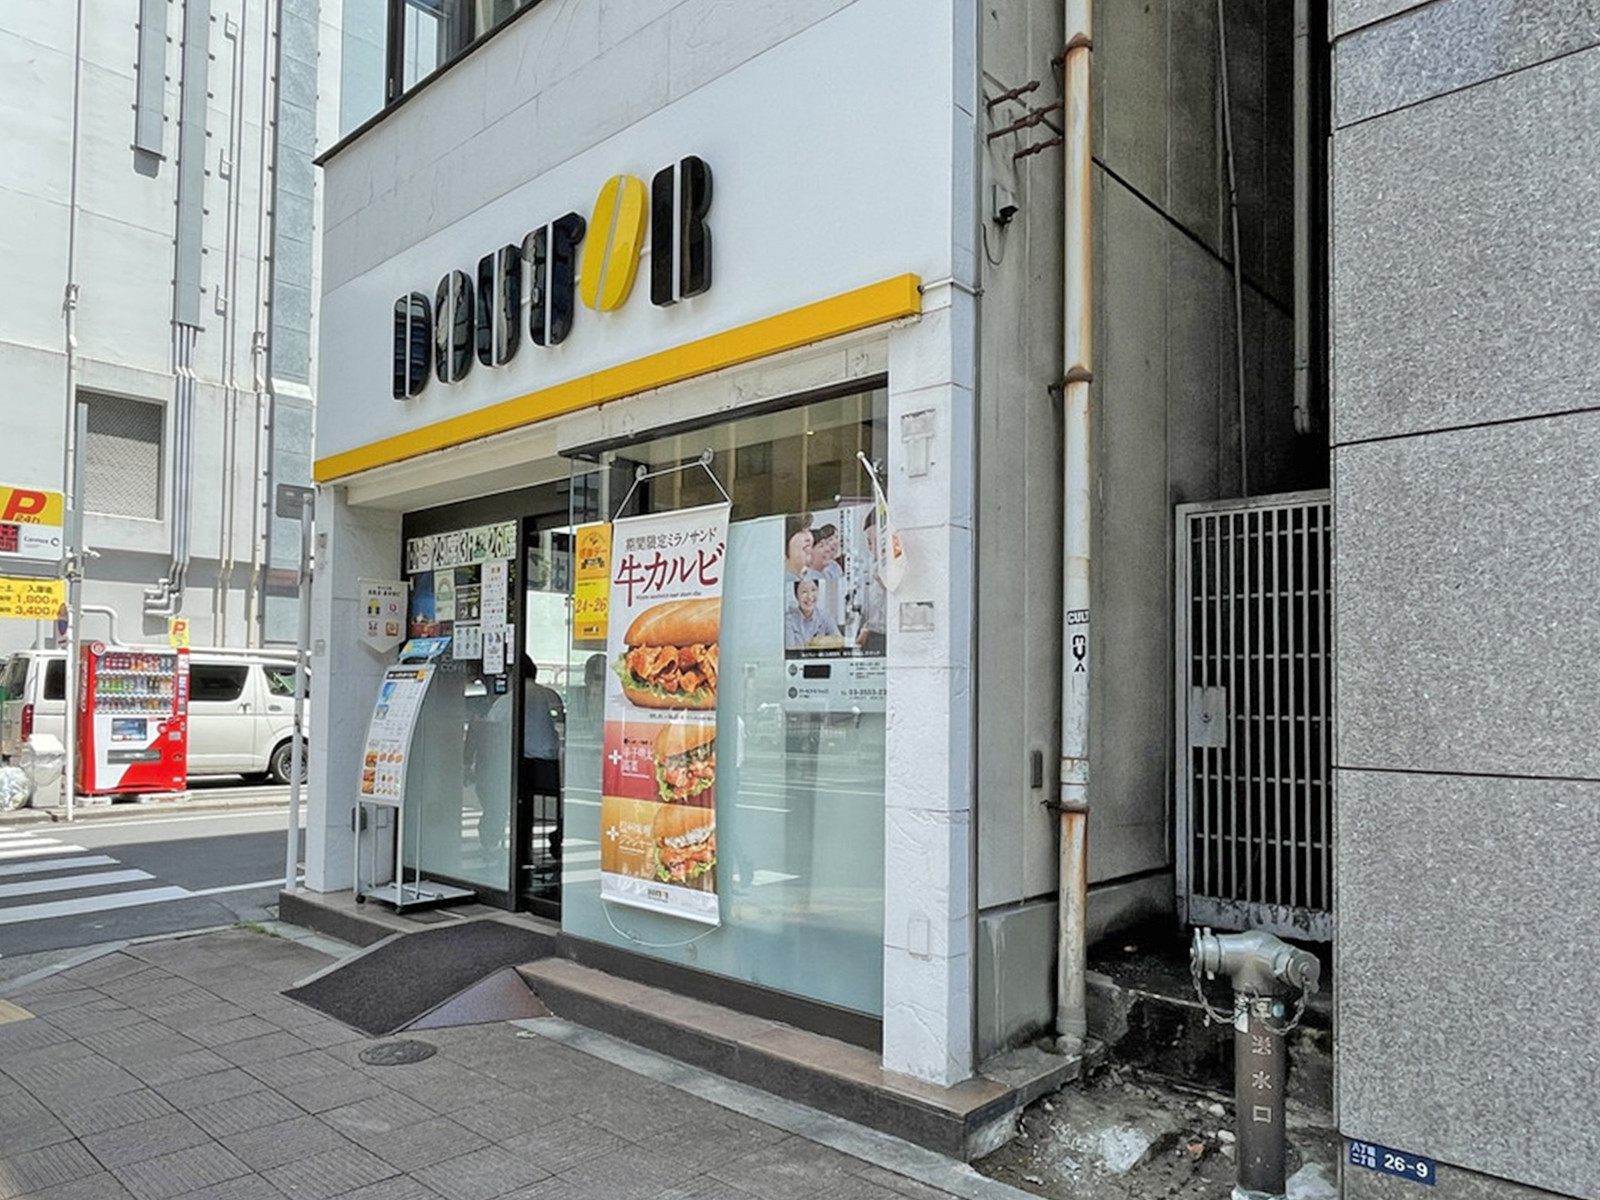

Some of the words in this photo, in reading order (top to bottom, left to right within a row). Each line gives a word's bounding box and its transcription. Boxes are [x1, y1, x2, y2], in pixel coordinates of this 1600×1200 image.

[392, 155, 713, 400] DOUTOR
[2, 489, 47, 520] P
[625, 526, 717, 551] 期間限定ミラノサンド
[614, 542, 725, 607] 牛カルビ
[172, 621, 186, 635] P
[1384, 1153, 1428, 1178] 26-9
